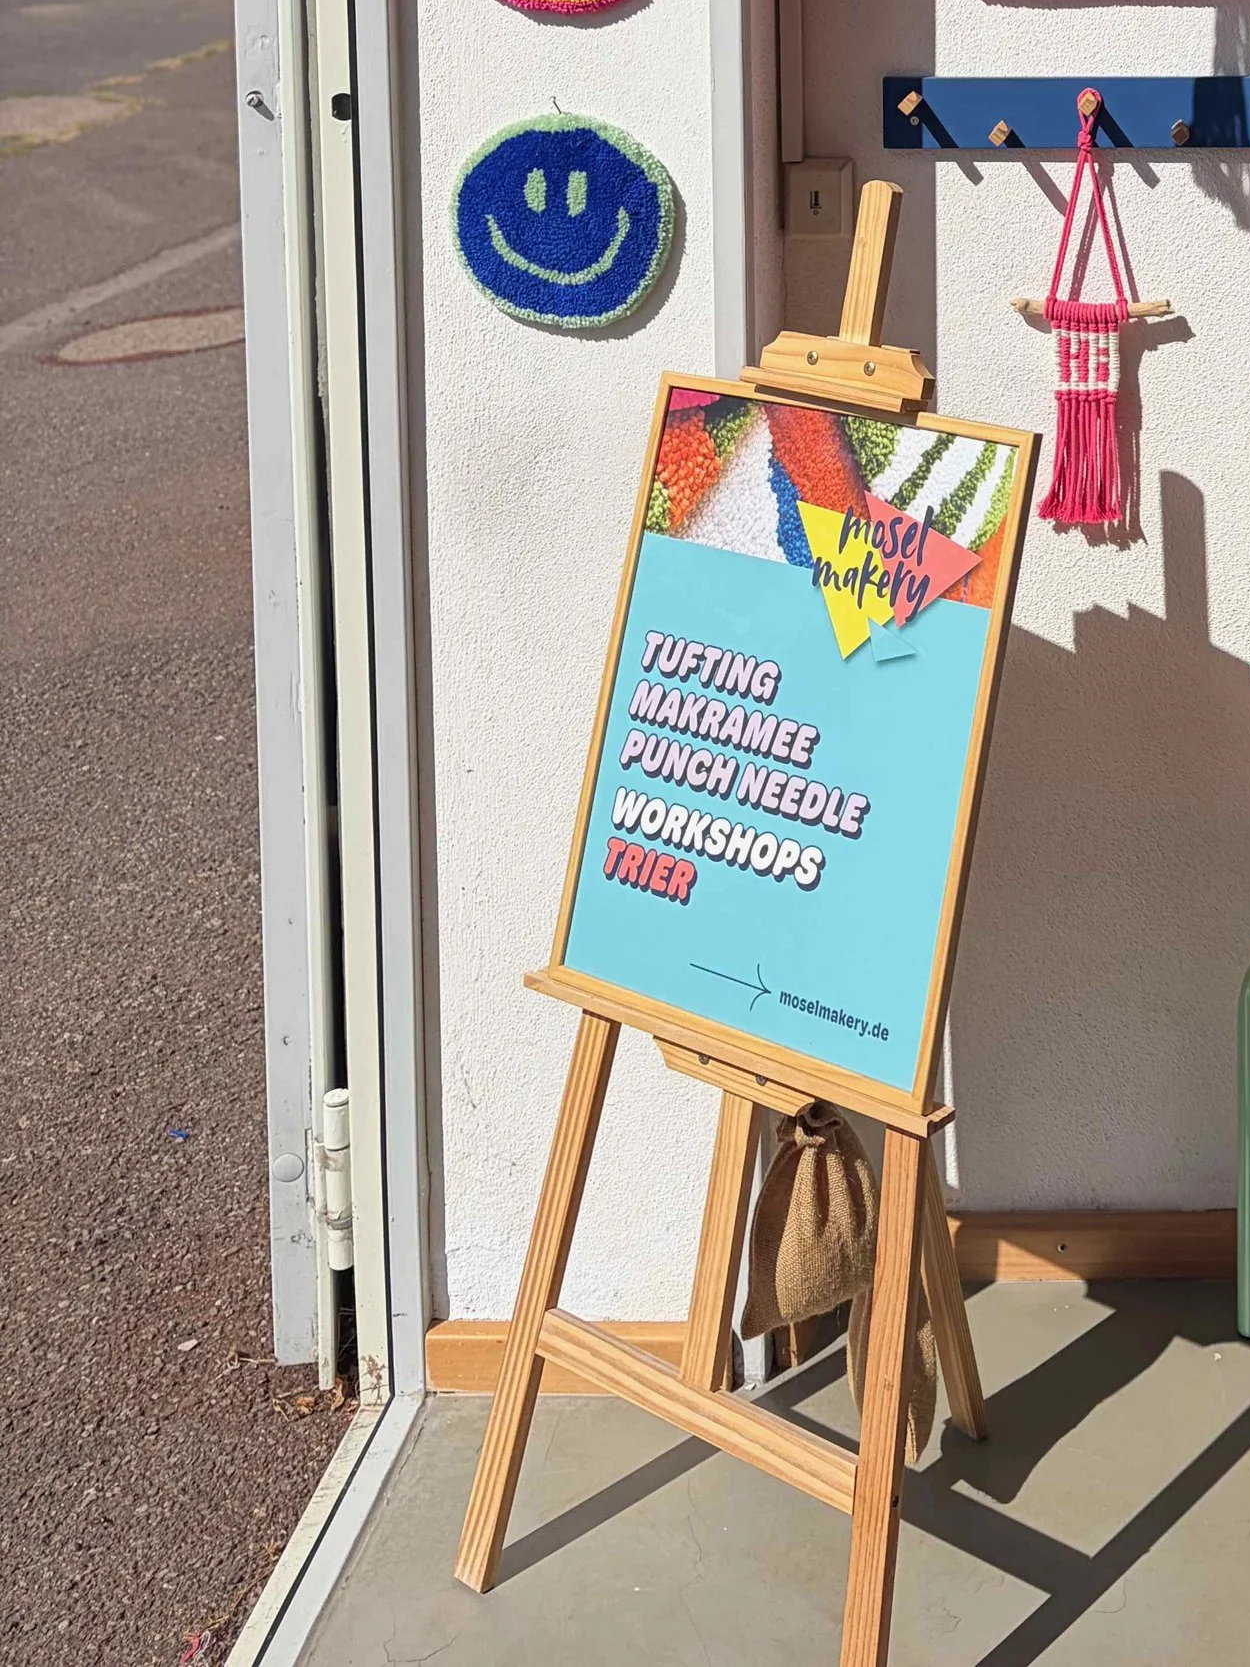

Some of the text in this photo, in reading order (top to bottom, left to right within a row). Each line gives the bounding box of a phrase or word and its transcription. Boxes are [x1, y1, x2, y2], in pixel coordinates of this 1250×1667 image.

[838, 505, 936, 568] mosel
[811, 556, 932, 624] makery
[640, 630, 781, 703] TUFTING
[628, 680, 820, 768] MAKRAMEE
[619, 729, 870, 837] PUNCH NEEDLE
[602, 838, 698, 906] TRIER
[610, 787, 826, 893] WORKSHOPS
[778, 987, 891, 1042] moselmakery.de
